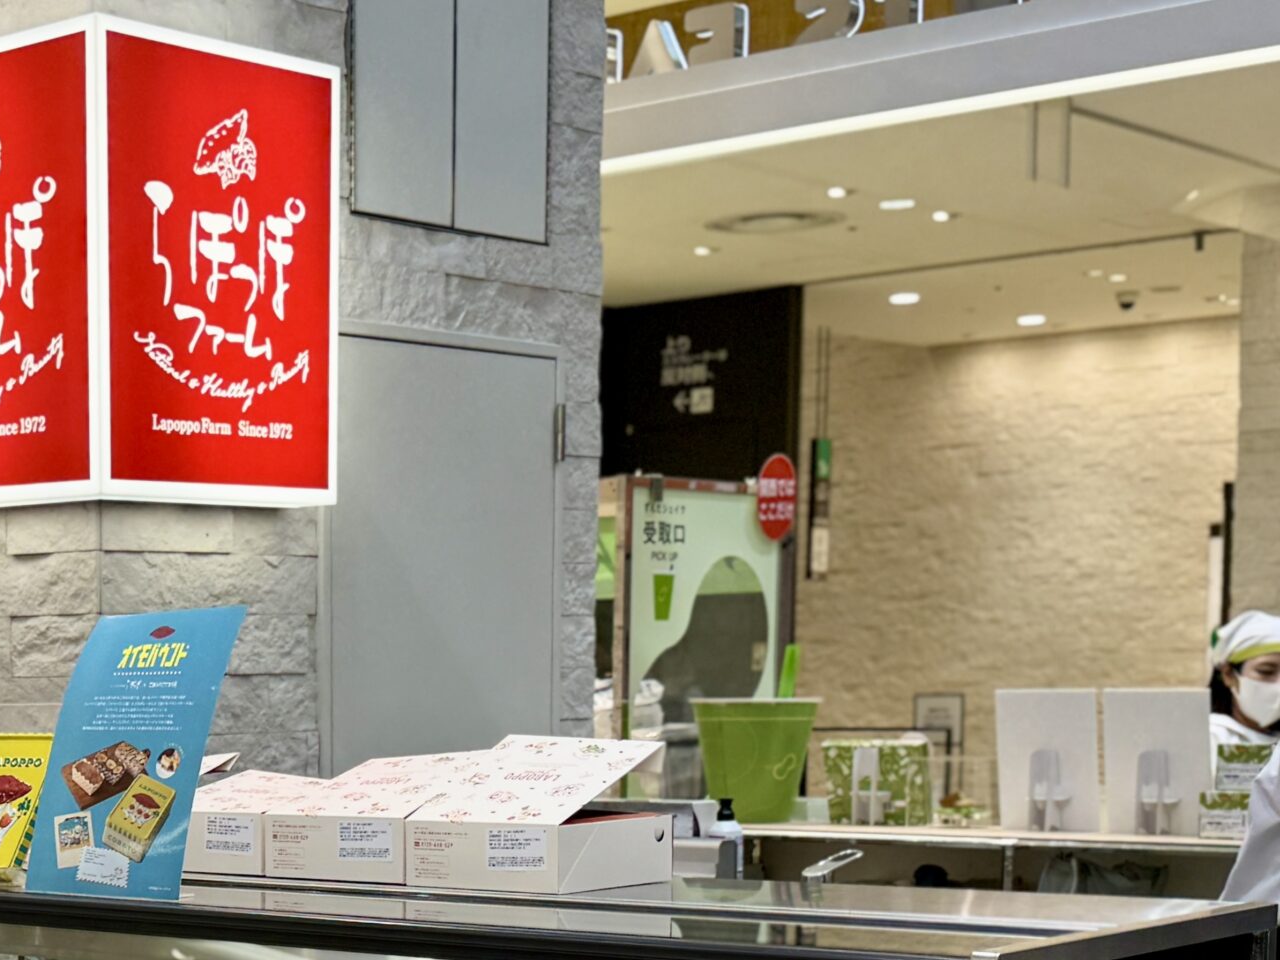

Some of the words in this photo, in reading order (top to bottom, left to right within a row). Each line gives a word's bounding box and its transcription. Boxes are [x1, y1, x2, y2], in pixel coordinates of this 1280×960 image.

[143, 180, 306, 321] らぽっぽ
[173, 304, 272, 360] ファーム
[20, 415, 47, 434] 1972
[152, 414, 200, 435] Lapoppo
[201, 417, 231, 436] Farm
[238, 420, 267, 438] Since
[268, 422, 293, 440] 1972
[643, 522, 686, 545] 受取口
